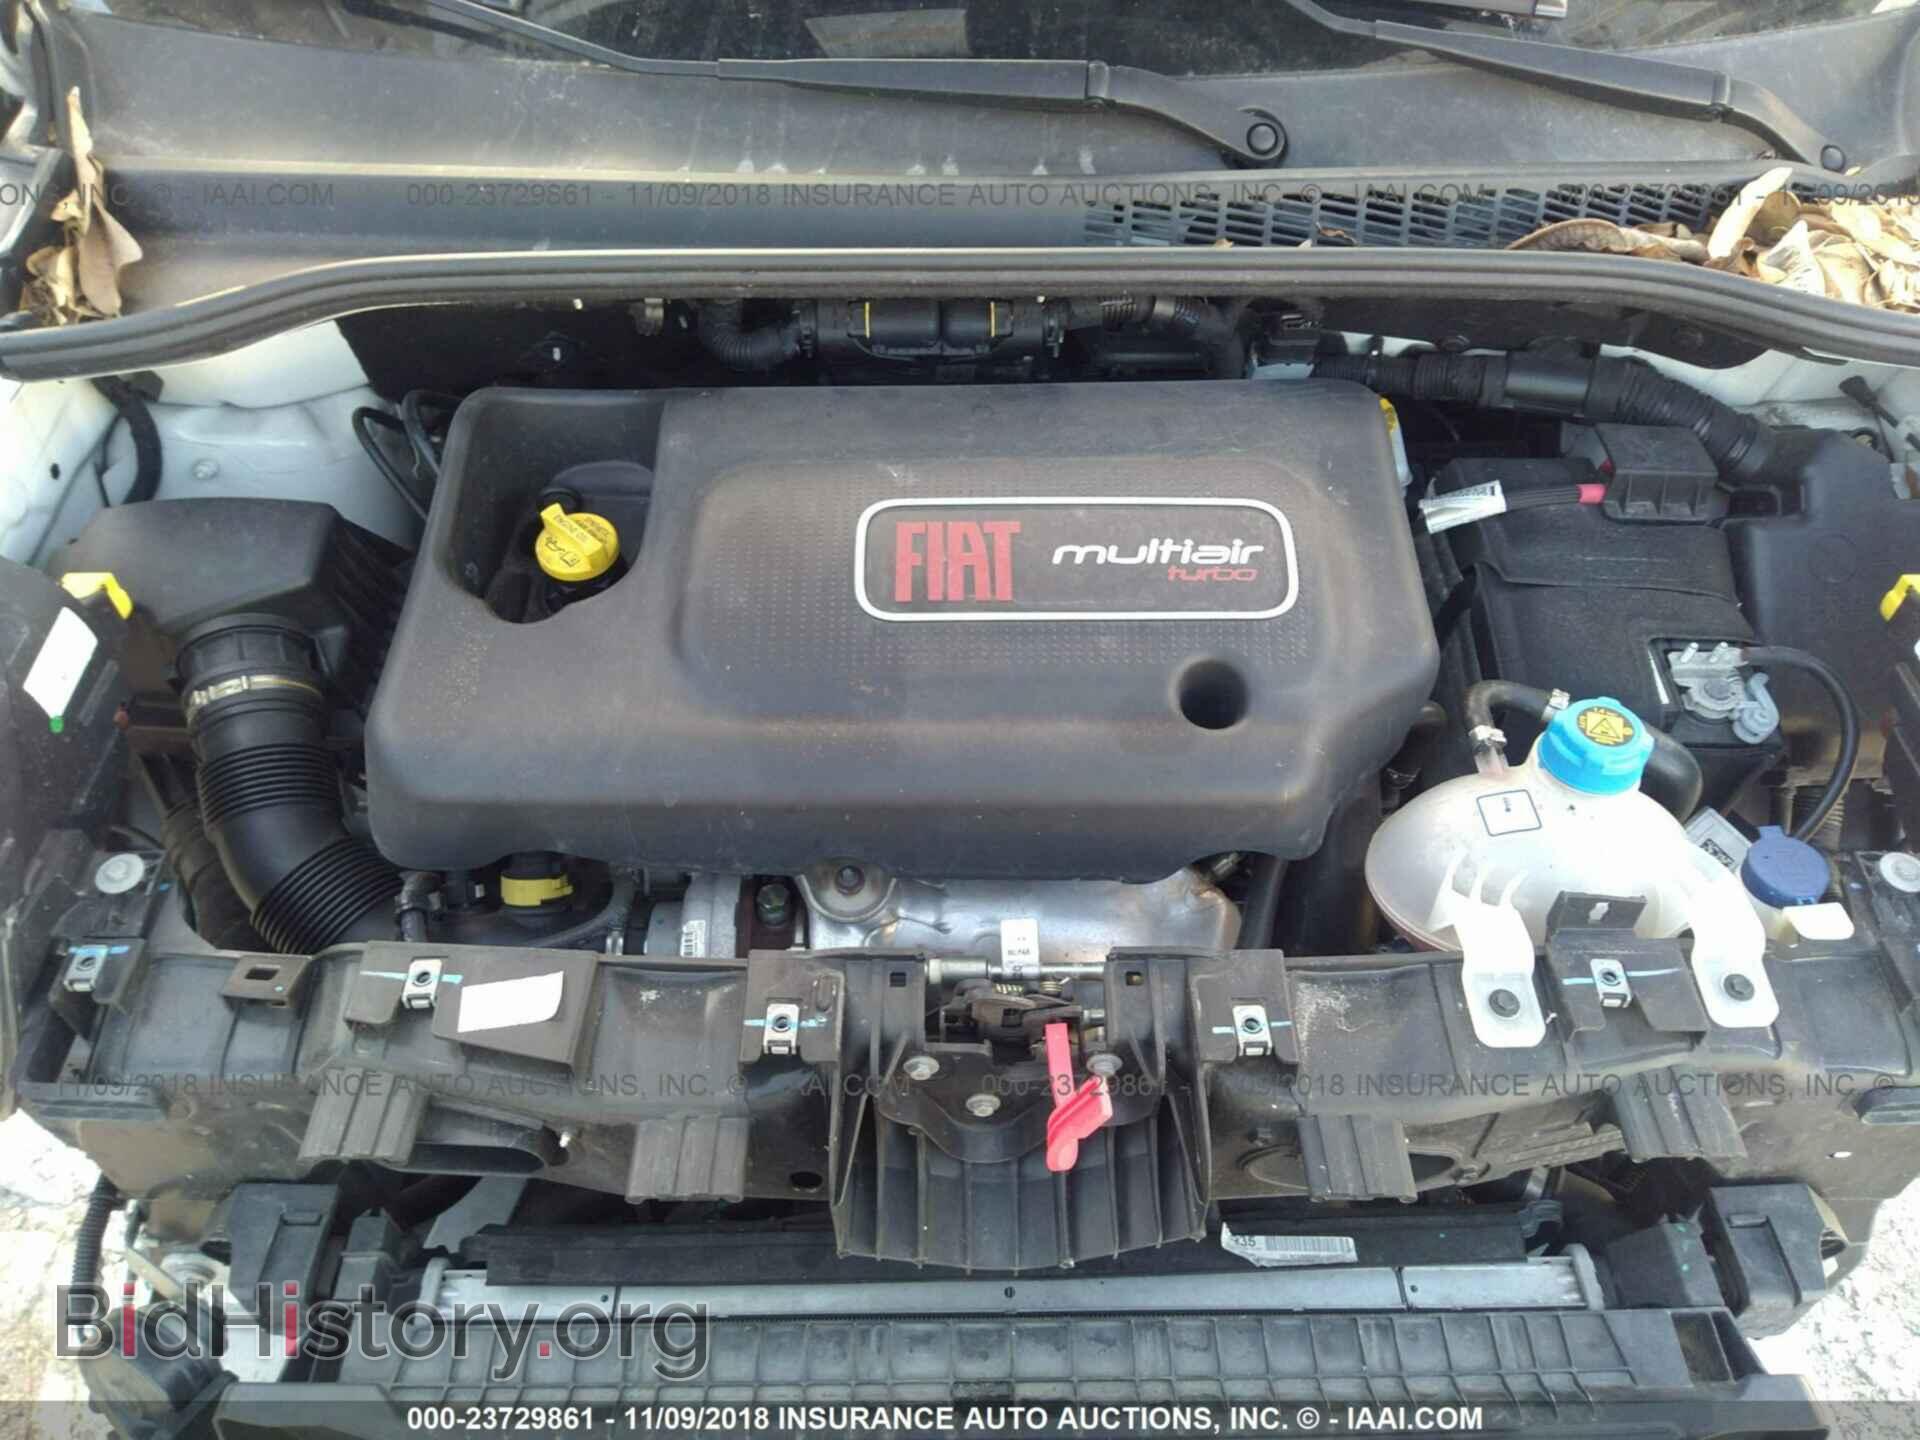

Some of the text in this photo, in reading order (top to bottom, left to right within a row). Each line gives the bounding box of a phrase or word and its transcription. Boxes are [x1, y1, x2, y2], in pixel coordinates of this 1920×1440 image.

[895, 521, 1264, 602] FIAT multiair
[1168, 566, 1258, 582] turbo
